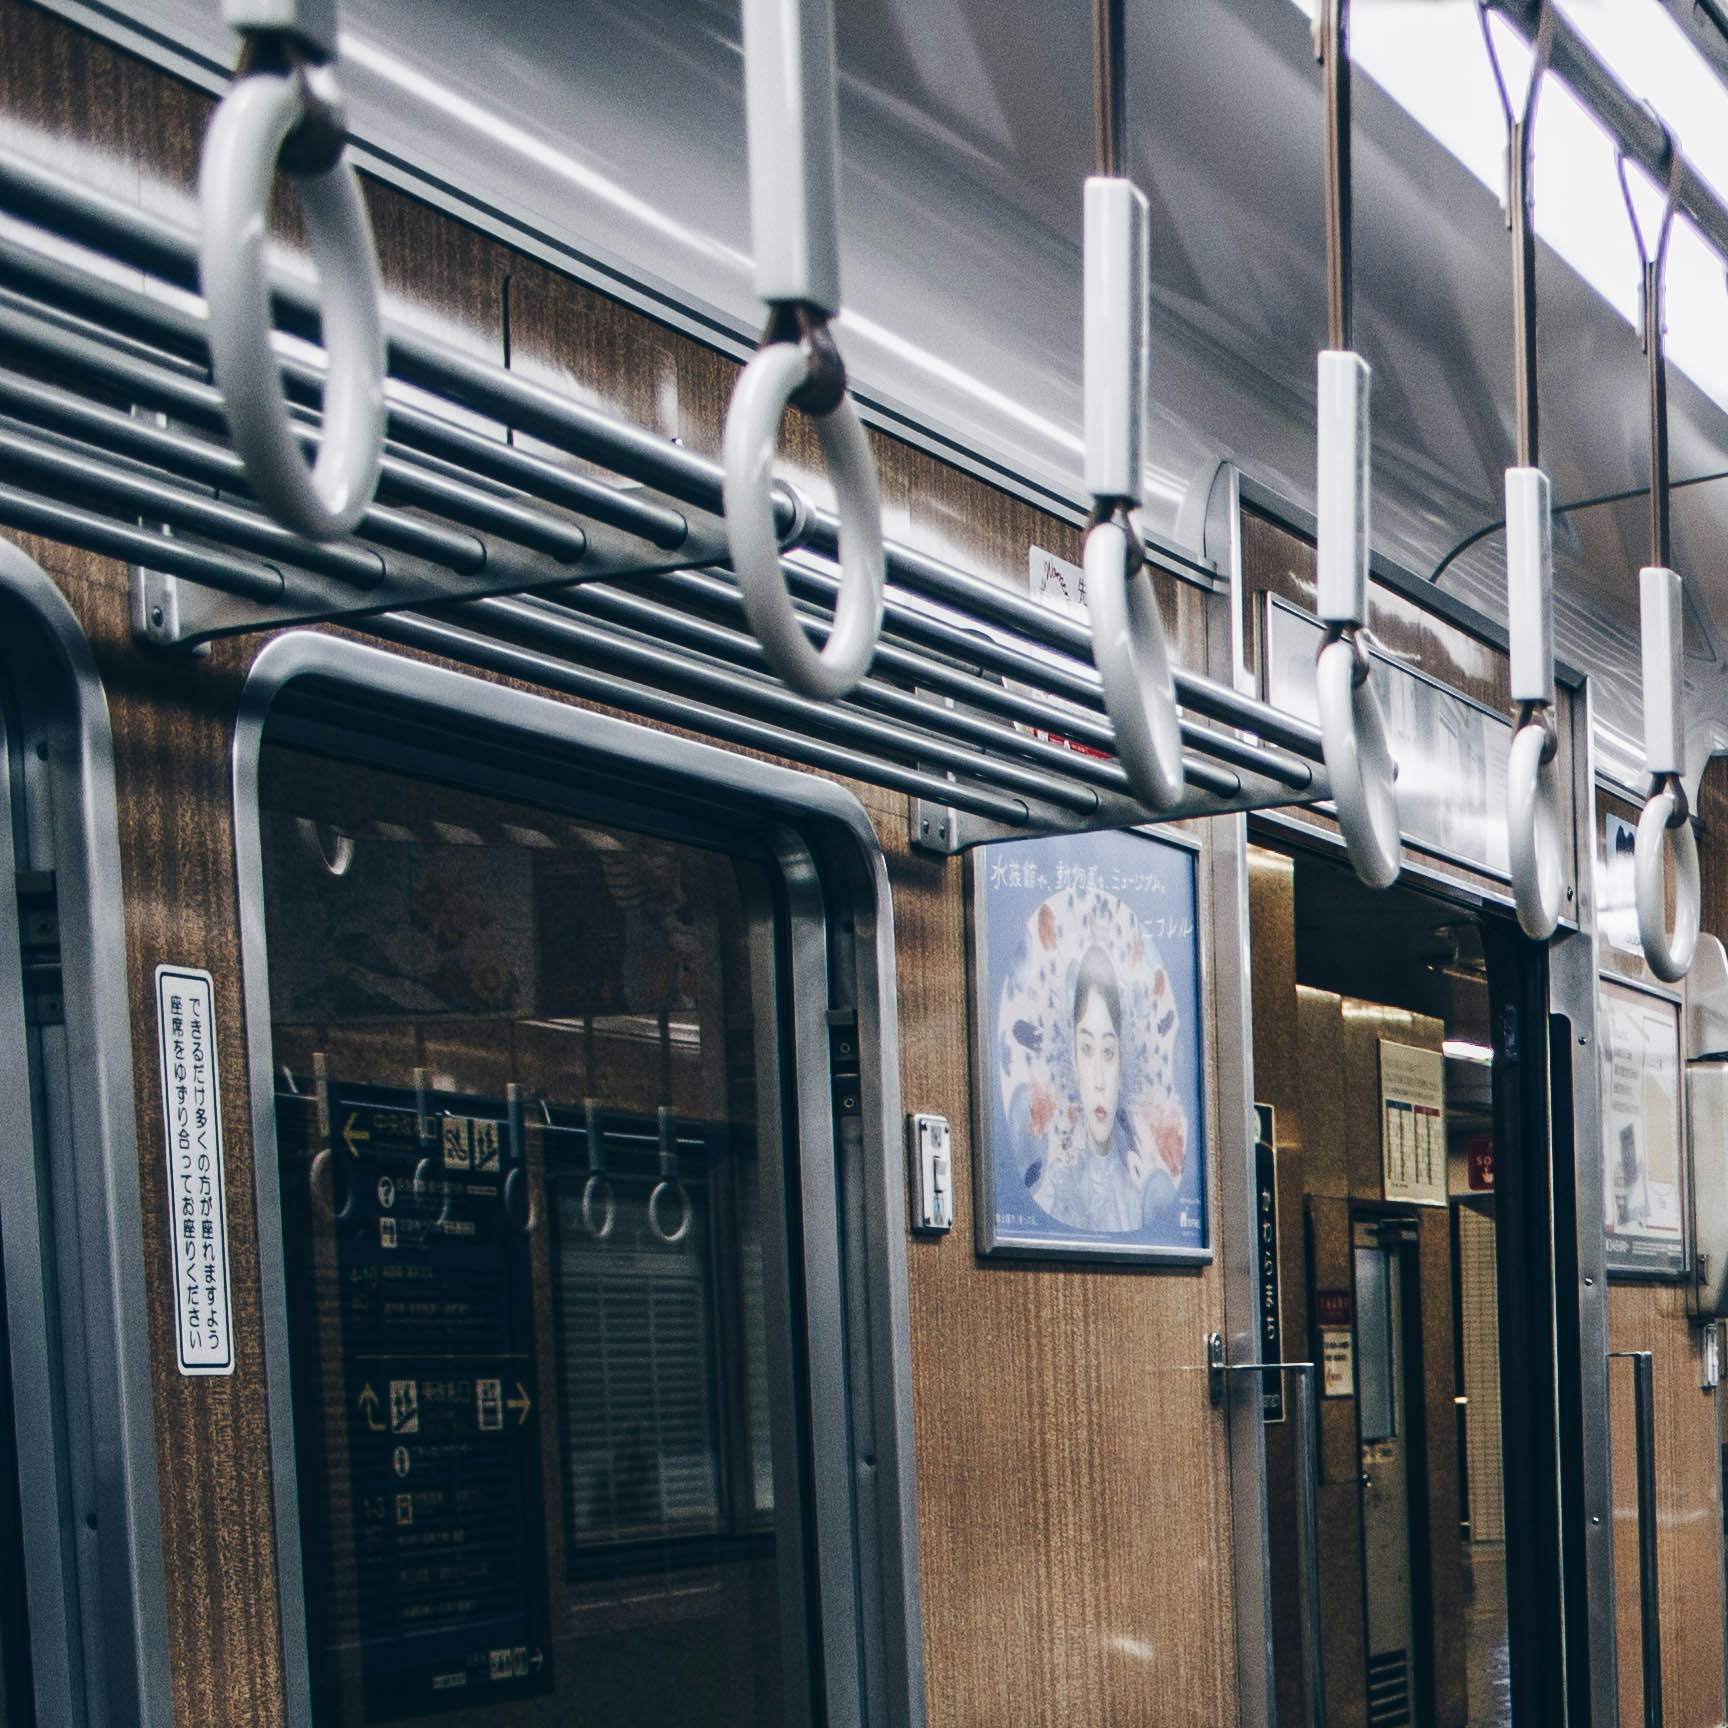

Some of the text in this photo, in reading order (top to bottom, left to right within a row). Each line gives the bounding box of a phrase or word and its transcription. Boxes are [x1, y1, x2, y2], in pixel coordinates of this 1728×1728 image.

[1143, 917, 1193, 939] ニフレル
[171, 995, 203, 1350] 座席をゆずり合ってお座りください
[189, 998, 220, 1350] できるだけ多くの方が座れますよう
